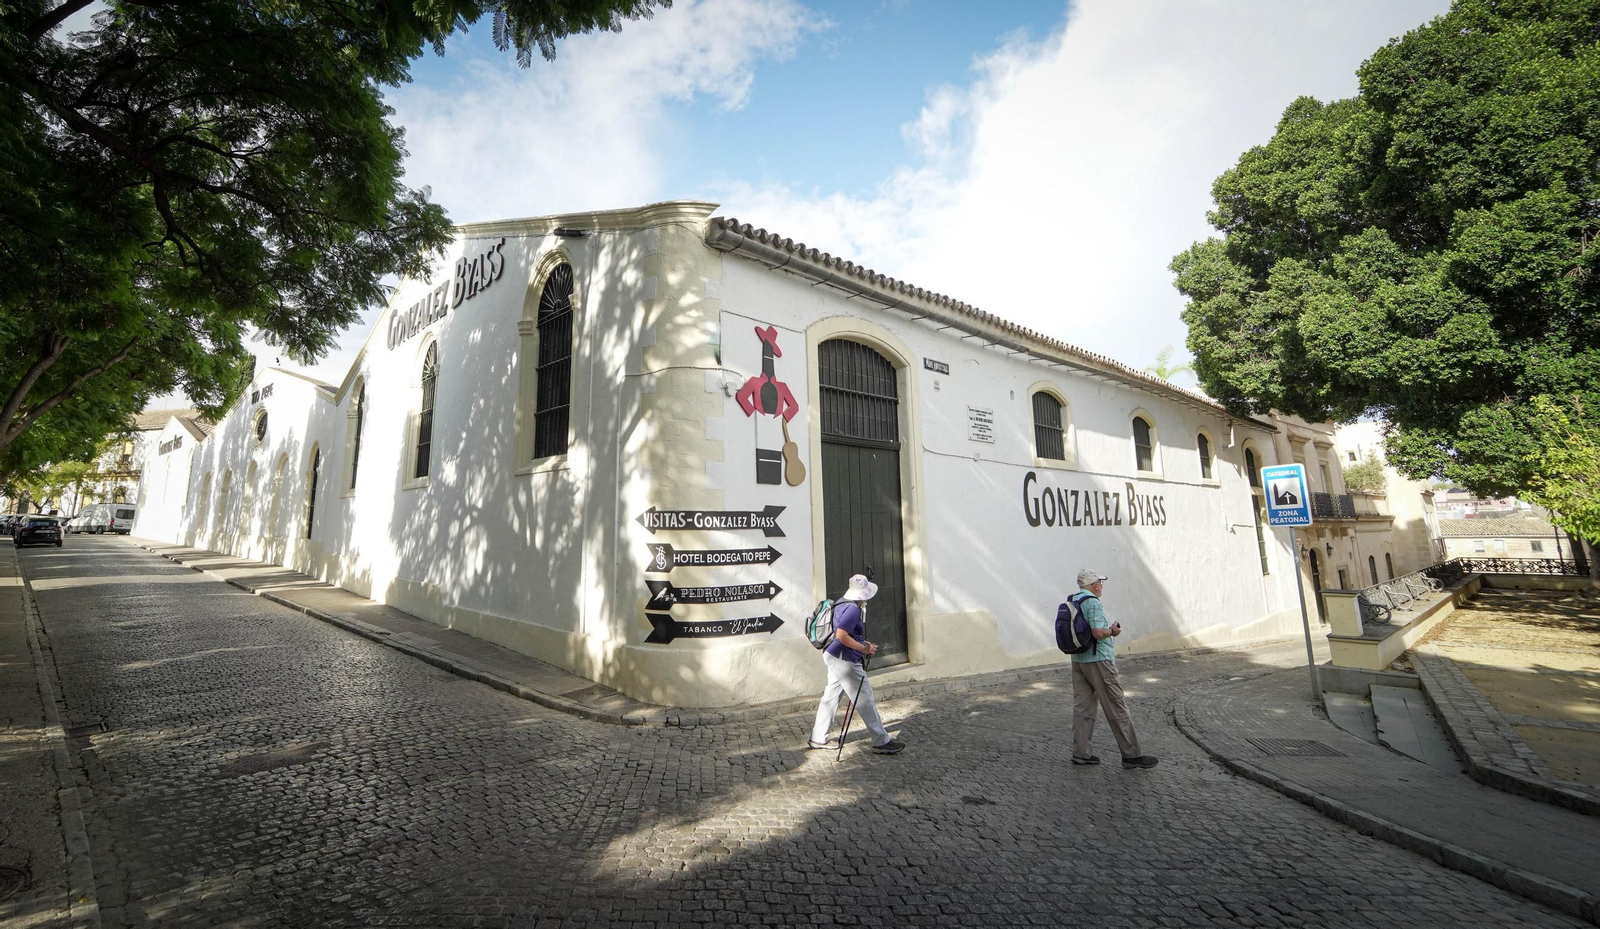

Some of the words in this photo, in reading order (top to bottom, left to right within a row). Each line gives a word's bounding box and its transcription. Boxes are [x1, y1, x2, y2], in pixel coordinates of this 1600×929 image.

[387, 279, 450, 351] GONZALEZ
[451, 237, 506, 310] BYASS
[1023, 471, 1122, 527] GONZALEZ
[1125, 481, 1166, 526] BYASS
[750, 513, 775, 528] BYASS
[673, 553, 705, 563] HOTEL
[707, 553, 741, 563] BODEGA
[742, 552, 753, 561] TIO
[755, 551, 771, 561] PEPE
[680, 588, 720, 598] PEDRO
[725, 584, 765, 597] NOLASCO
[706, 594, 747, 602] RESTAURANTE
[683, 625, 723, 633] TABANCO
